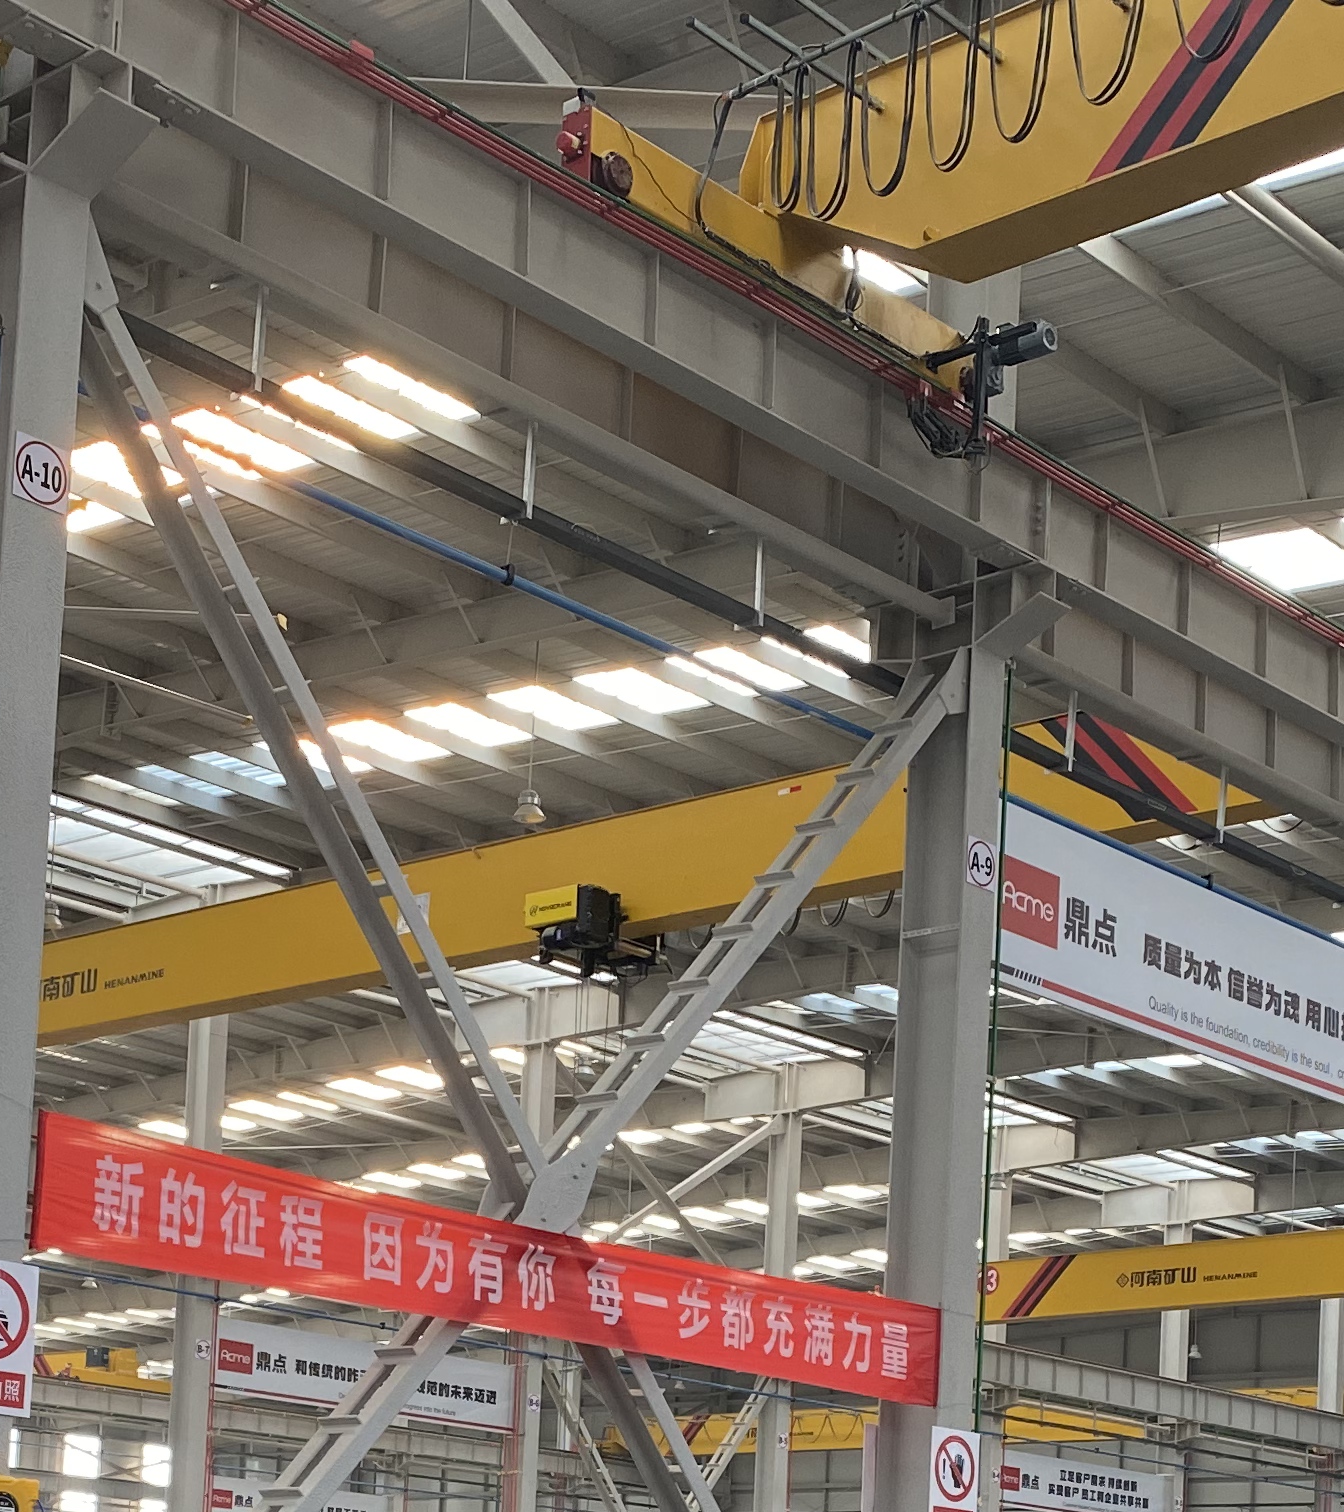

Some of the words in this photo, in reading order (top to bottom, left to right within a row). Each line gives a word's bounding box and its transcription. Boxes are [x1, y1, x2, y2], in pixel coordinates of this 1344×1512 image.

[21, 453, 62, 494] A-10
[970, 854, 994, 877] A-9
[1001, 880, 1055, 924] Acme
[1064, 896, 1118, 958] 鼎点
[40, 968, 98, 1003] 南矿山
[1143, 933, 1222, 992] 质量为本
[1227, 967, 1301, 1024] 信誉为魂
[1148, 995, 1179, 1019] Quality
[1181, 1007, 1188, 1023] is
[1190, 1012, 1204, 1029] the
[1206, 1016, 1251, 1047] foundation,
[1252, 1036, 1290, 1063] credibility
[1291, 1047, 1298, 1063] is
[1300, 1052, 1313, 1069] the
[92, 1154, 325, 1271] 新的征程
[363, 1211, 555, 1311] 因为有你
[586, 1257, 910, 1381] 每一步都充满力量
[1130, 1266, 1197, 1288] 河南矿山
[220, 1350, 251, 1365] Acme
[255, 1351, 287, 1374] 鼎点
